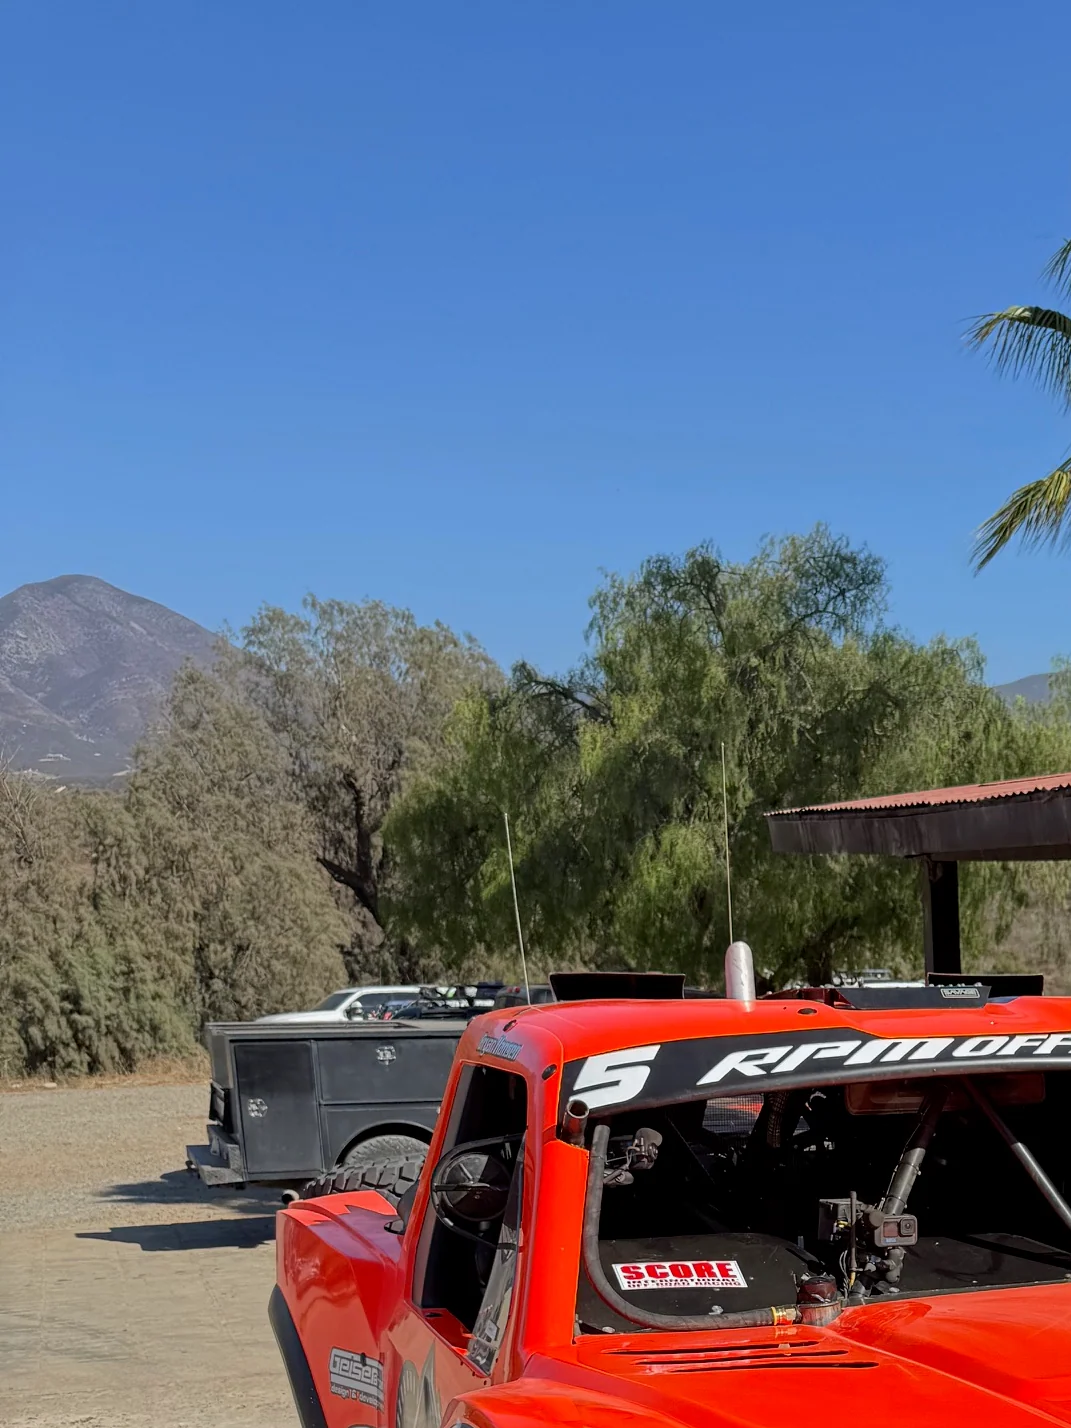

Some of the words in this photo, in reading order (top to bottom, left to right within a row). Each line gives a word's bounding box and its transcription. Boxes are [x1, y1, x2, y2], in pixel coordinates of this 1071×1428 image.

[569, 1045, 660, 1110] 5
[696, 1037, 955, 1086] RPM
[620, 1262, 737, 1279] SCORE
